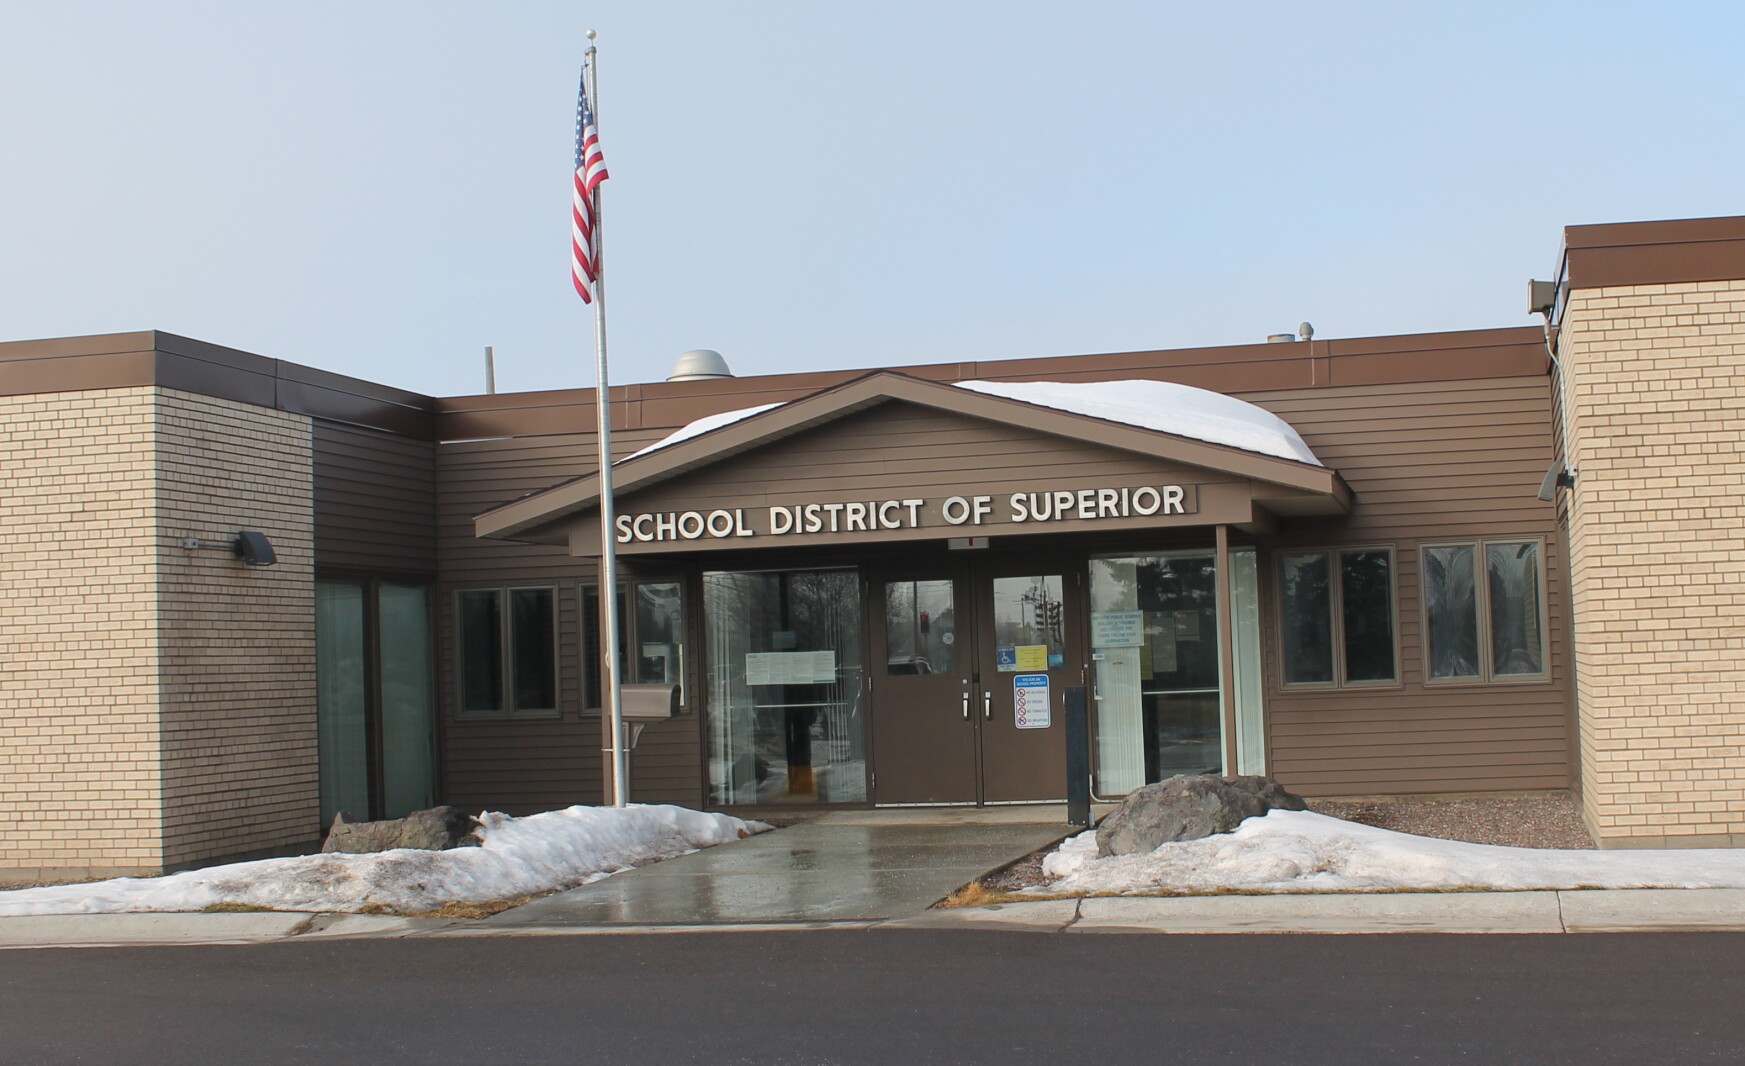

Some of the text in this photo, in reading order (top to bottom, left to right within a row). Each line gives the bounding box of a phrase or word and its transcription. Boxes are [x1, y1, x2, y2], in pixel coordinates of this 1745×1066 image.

[616, 486, 1185, 543] SCHOOL DISTRICT OF SUPERIOR
